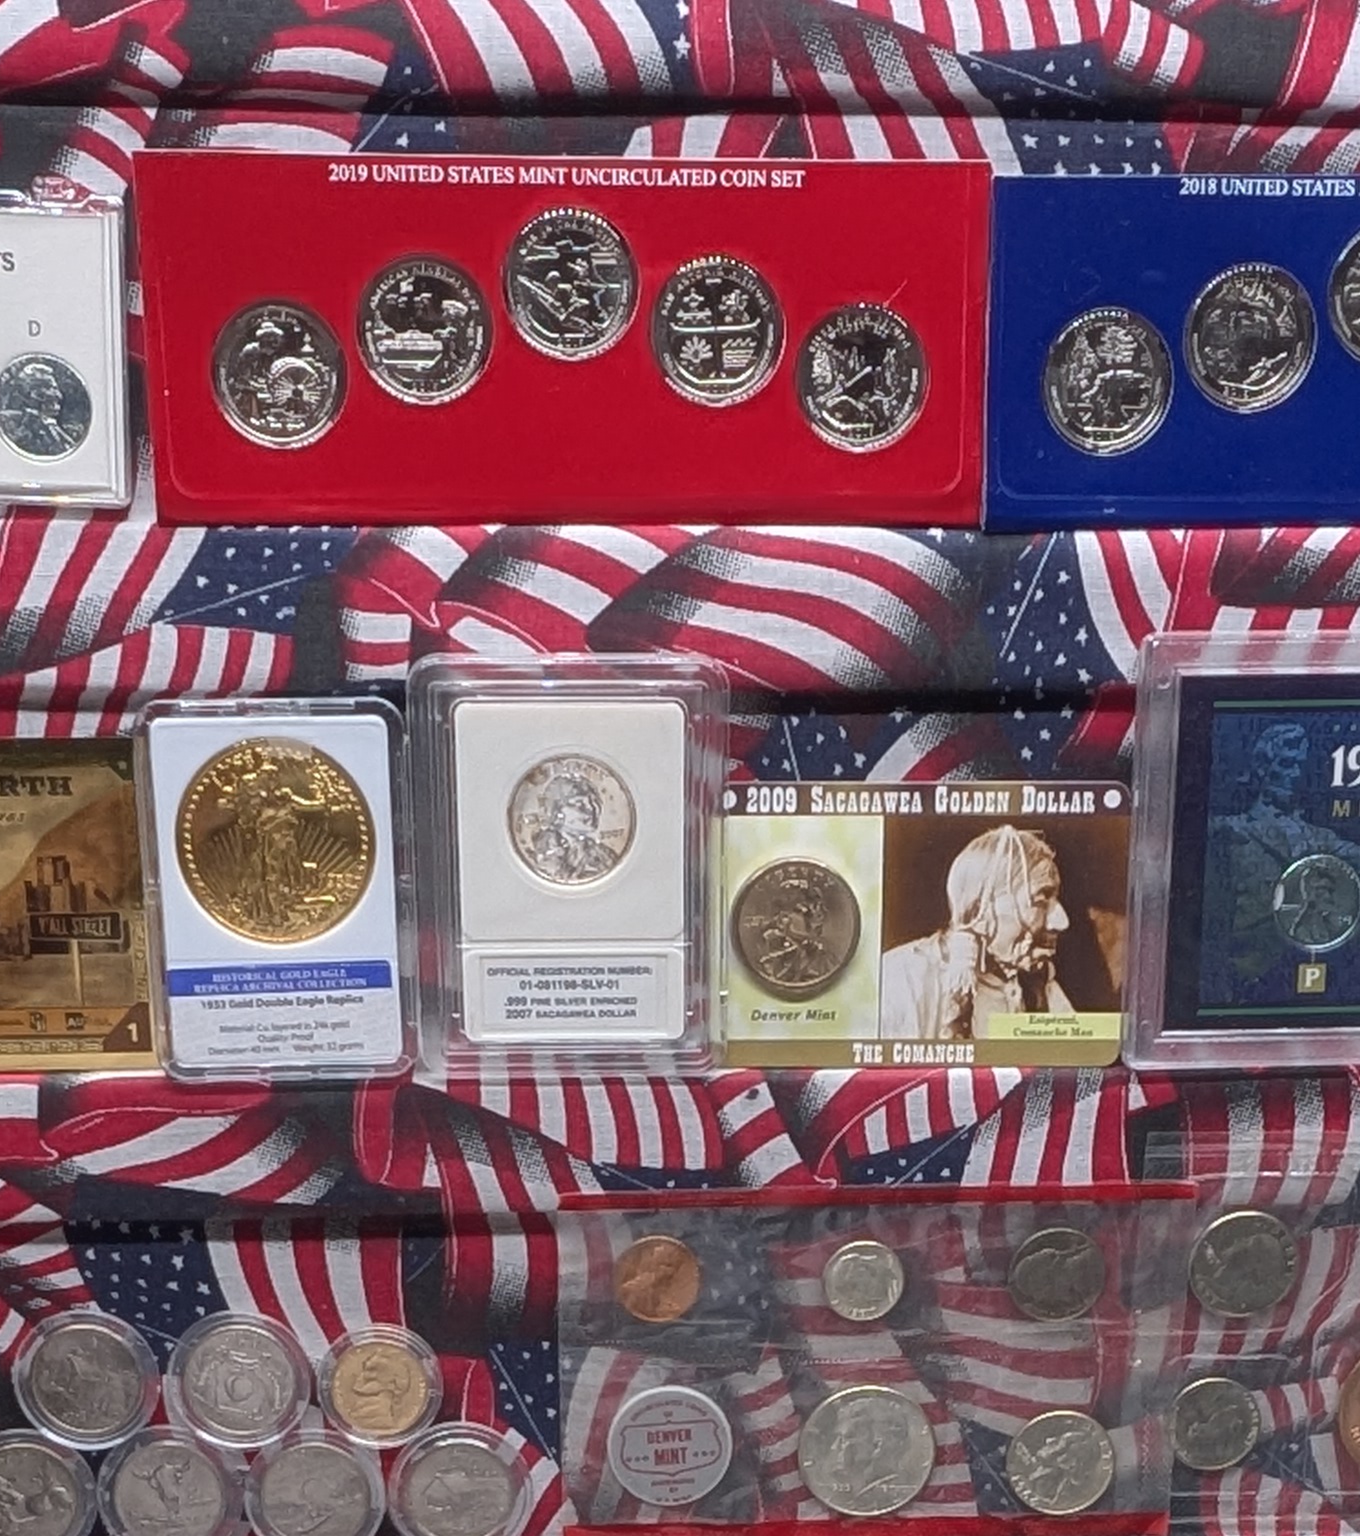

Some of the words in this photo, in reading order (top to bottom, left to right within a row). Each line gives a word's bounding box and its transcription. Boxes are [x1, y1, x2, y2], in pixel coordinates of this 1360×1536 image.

[328, 163, 368, 182] 2019
[372, 164, 443, 184] UNITED
[447, 165, 515, 184] STATES
[519, 167, 568, 185] MINT
[571, 167, 717, 187] UNCIRCULATED
[720, 169, 767, 187] COIN
[771, 169, 806, 188] SET
[1179, 178, 1217, 196] 2018
[1221, 178, 1289, 197] UNITED
[1292, 178, 1356, 197] STATES
[28, 320, 42, 338] D
[746, 786, 798, 814] 2009
[810, 786, 923, 814] SACAGAWEA
[934, 785, 1010, 814] GOLDEN
[1021, 785, 1096, 814] DOLLAR
[212, 970, 278, 983] HISTORICAL
[279, 969, 312, 981] GOLD
[487, 967, 531, 977] OFFICIAL
[533, 966, 606, 976] REGISTRATION
[1305, 966, 1319, 988] P
[193, 983, 241, 994] REPLICA
[296, 977, 368, 990] COLLECTION
[228, 998, 254, 1009] Gold
[255, 996, 294, 1009] Double
[296, 996, 325, 1009] Eagle
[326, 994, 365, 1007] Replica
[535, 1009, 596, 1019] SACAGAWEA
[598, 1009, 637, 1018] DOLLAR
[750, 1008, 797, 1022] Denver
[805, 1008, 838, 1022] Mint
[126, 1022, 139, 1044] 1
[852, 1043, 884, 1063] THE
[892, 1041, 976, 1063] COMANCHE
[646, 1428, 693, 1444] DENVER
[654, 1447, 688, 1466] MINT
